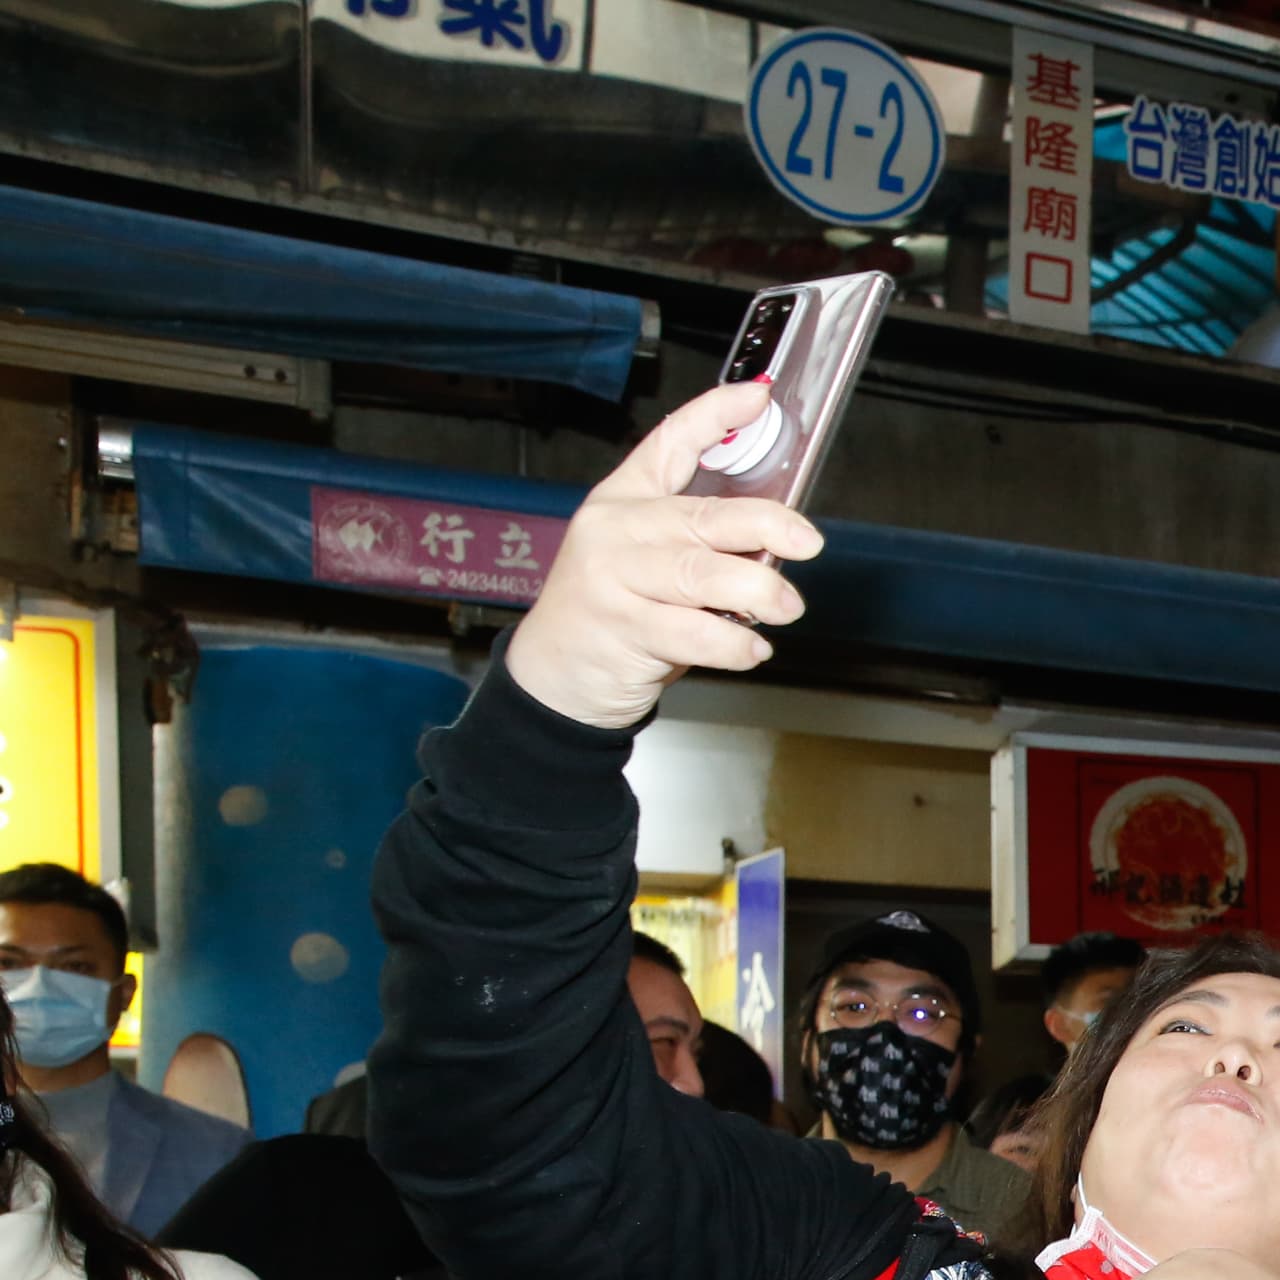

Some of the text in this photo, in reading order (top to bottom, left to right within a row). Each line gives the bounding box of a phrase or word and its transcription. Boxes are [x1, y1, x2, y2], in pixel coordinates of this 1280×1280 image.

[785, 60, 904, 194] 27-2
[1023, 52, 1083, 306] 基隆廟口
